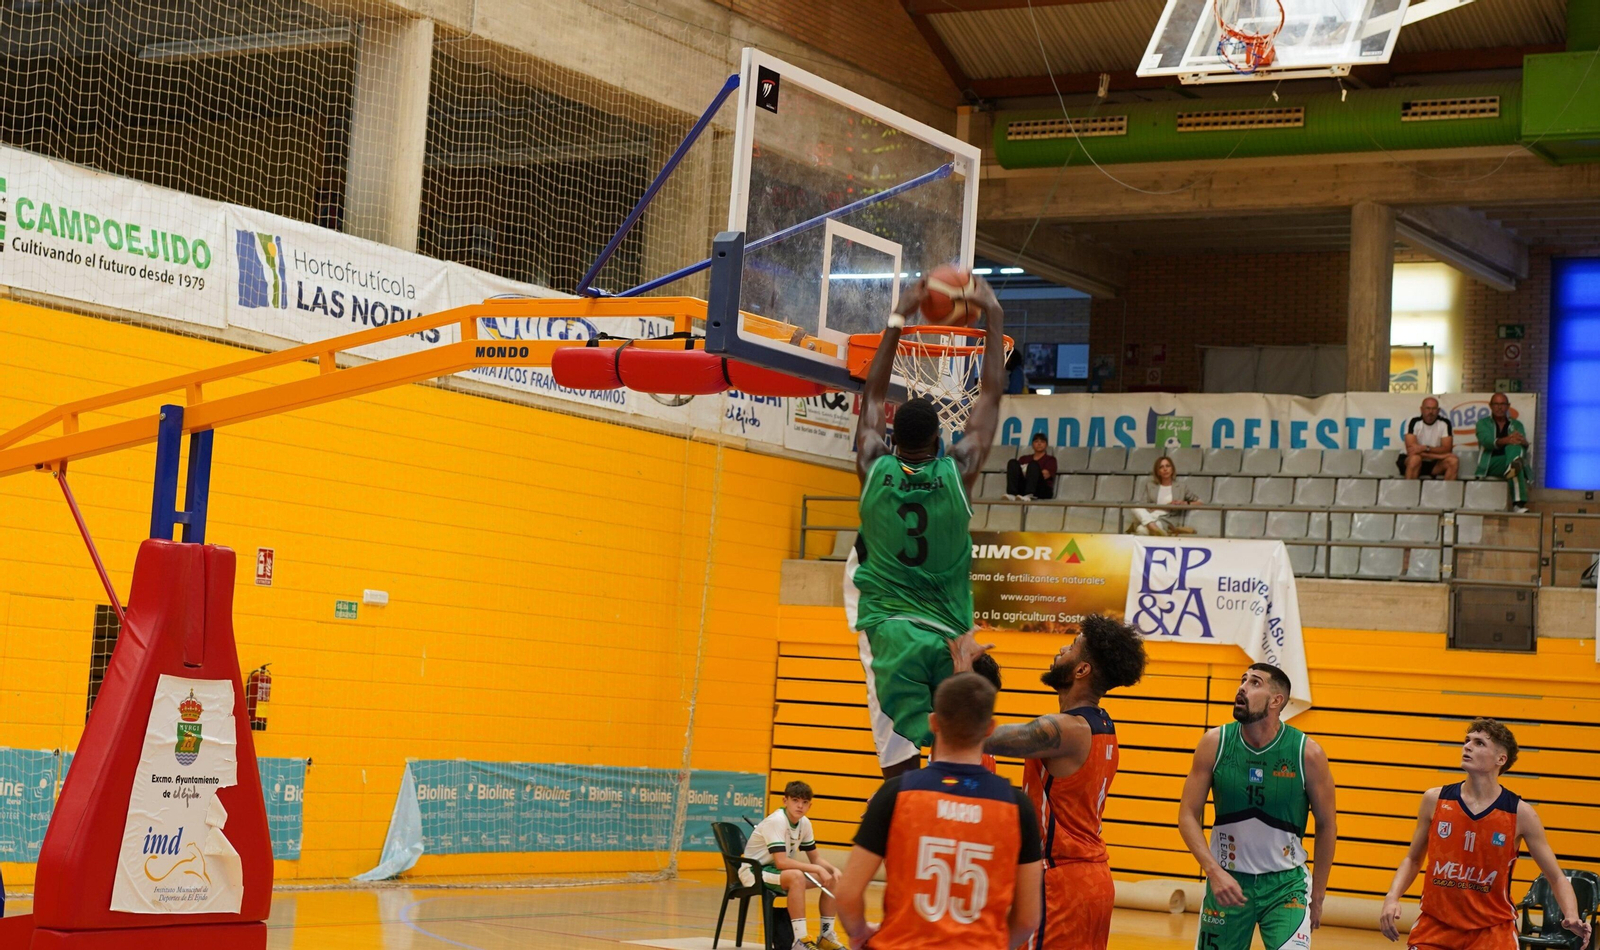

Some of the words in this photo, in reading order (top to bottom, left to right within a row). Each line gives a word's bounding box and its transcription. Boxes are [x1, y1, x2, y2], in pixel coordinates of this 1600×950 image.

[16, 197, 211, 270] CAMPOEJIDO
[12, 237, 81, 265] Cultivando
[85, 253, 96, 268] el
[98, 255, 136, 277] futuro
[139, 265, 174, 284] desde
[178, 273, 205, 290] 1979
[294, 249, 416, 299] Hortofrutícola
[296, 281, 344, 318] LAS
[476, 347, 529, 357] MONDO
[1211, 417, 1406, 449] CELESTE
[896, 502, 928, 567] 3
[972, 545, 1052, 560] RIMOR
[993, 572, 1004, 582] de
[1006, 573, 1059, 583] fertilizantes
[1062, 576, 1105, 585] naturales
[1138, 546, 1212, 595] EP
[1000, 594, 1066, 604] www.agrimor.es
[982, 612, 989, 620] a
[991, 610, 1001, 620] la
[1002, 611, 1056, 624] agricultura
[1132, 587, 1214, 638] &A
[175, 775, 219, 785] Ayuntamiento
[163, 790, 170, 798] de
[417, 784, 458, 800] Bioline
[477, 784, 516, 800] Bioline
[534, 785, 572, 800] Bioline
[588, 786, 622, 801] Bioline
[640, 788, 672, 802] Bioline
[688, 790, 718, 805] Bioline
[733, 792, 763, 807] Bioline
[1246, 784, 1265, 807] 15
[143, 826, 184, 855] imd
[1464, 831, 1476, 853] 11
[913, 836, 995, 924] 55
[1432, 861, 1498, 886] MELILLA
